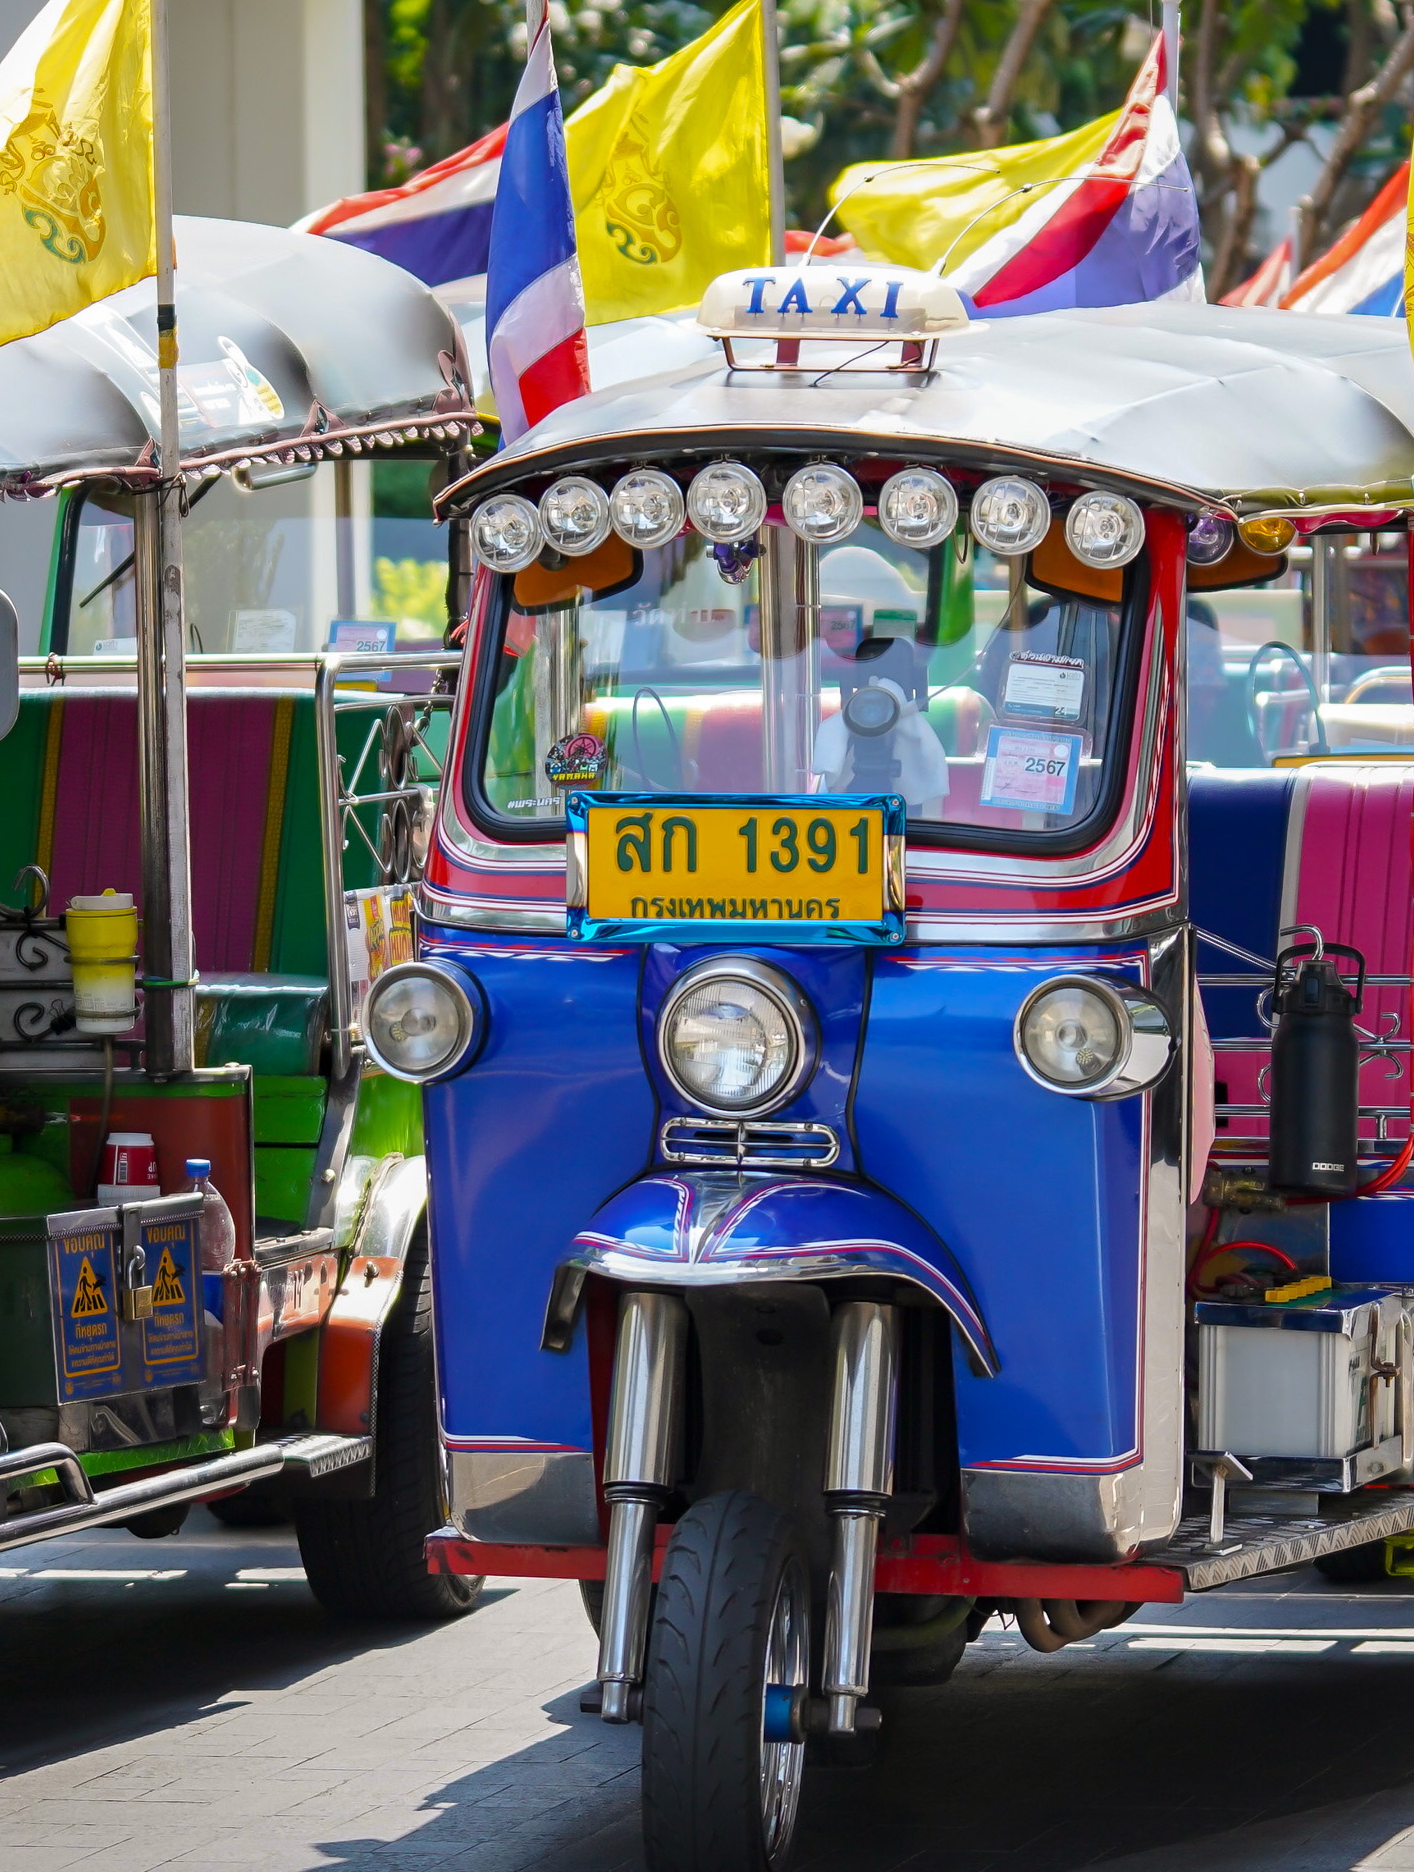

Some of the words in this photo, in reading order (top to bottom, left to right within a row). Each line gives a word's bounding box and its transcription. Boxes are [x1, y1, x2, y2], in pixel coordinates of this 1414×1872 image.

[742, 277, 904, 318] TAXI
[356, 640, 386, 653] 2567
[552, 772, 596, 780] YAMAHA
[1025, 757, 1066, 776] 2567
[616, 812, 697, 872] สก
[739, 816, 869, 873] 1391
[631, 897, 840, 919] กรงเทพมหานคร
[63, 1233, 105, 1258] ขอบคุณ
[146, 1225, 185, 1248] ขอบคุณ
